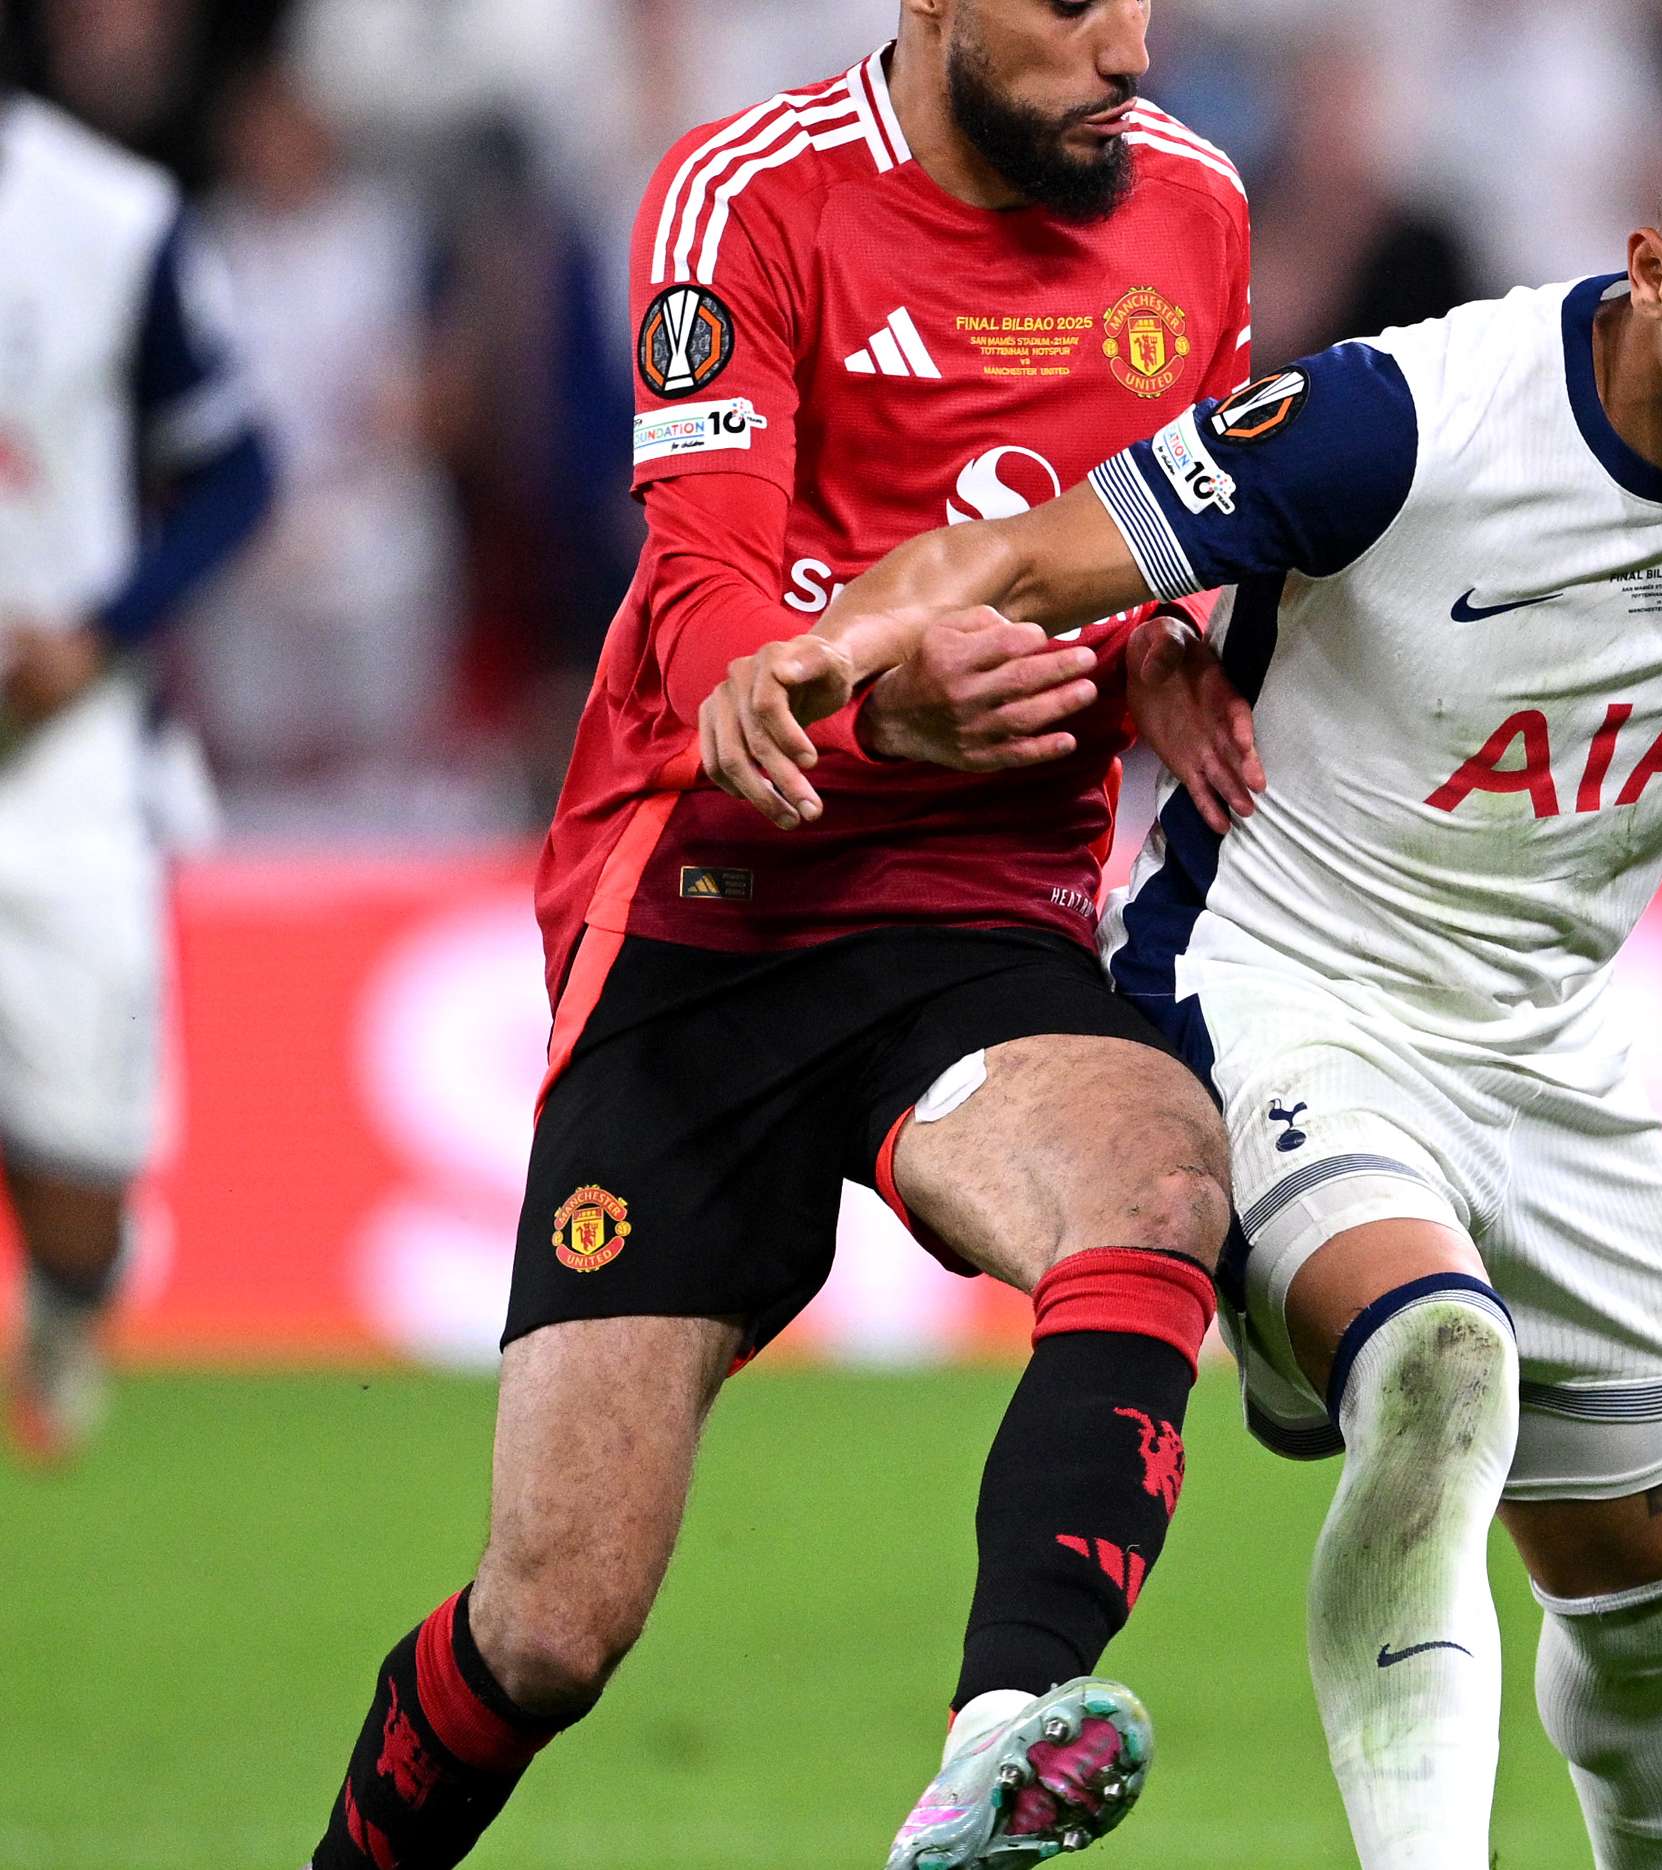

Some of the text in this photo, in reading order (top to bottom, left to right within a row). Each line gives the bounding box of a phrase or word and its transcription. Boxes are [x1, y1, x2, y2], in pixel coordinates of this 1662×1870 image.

[956, 316, 1093, 331] FINAL BILBAO 2025
[970, 336, 987, 345] SAN
[1017, 337, 1050, 346] STADIUM
[1110, 295, 1180, 390] MANCHESTER UNITED
[981, 347, 1071, 356] TOTTENHAM HOTSPUR
[983, 366, 1071, 376] MANCHESTER UNITED
[707, 411, 746, 435] 10
[634, 421, 704, 445] OUNDATION
[1184, 461, 1215, 499] 10
[1609, 571, 1643, 582] FINAL
[559, 1191, 621, 1267] MANCHESTER UNITED
